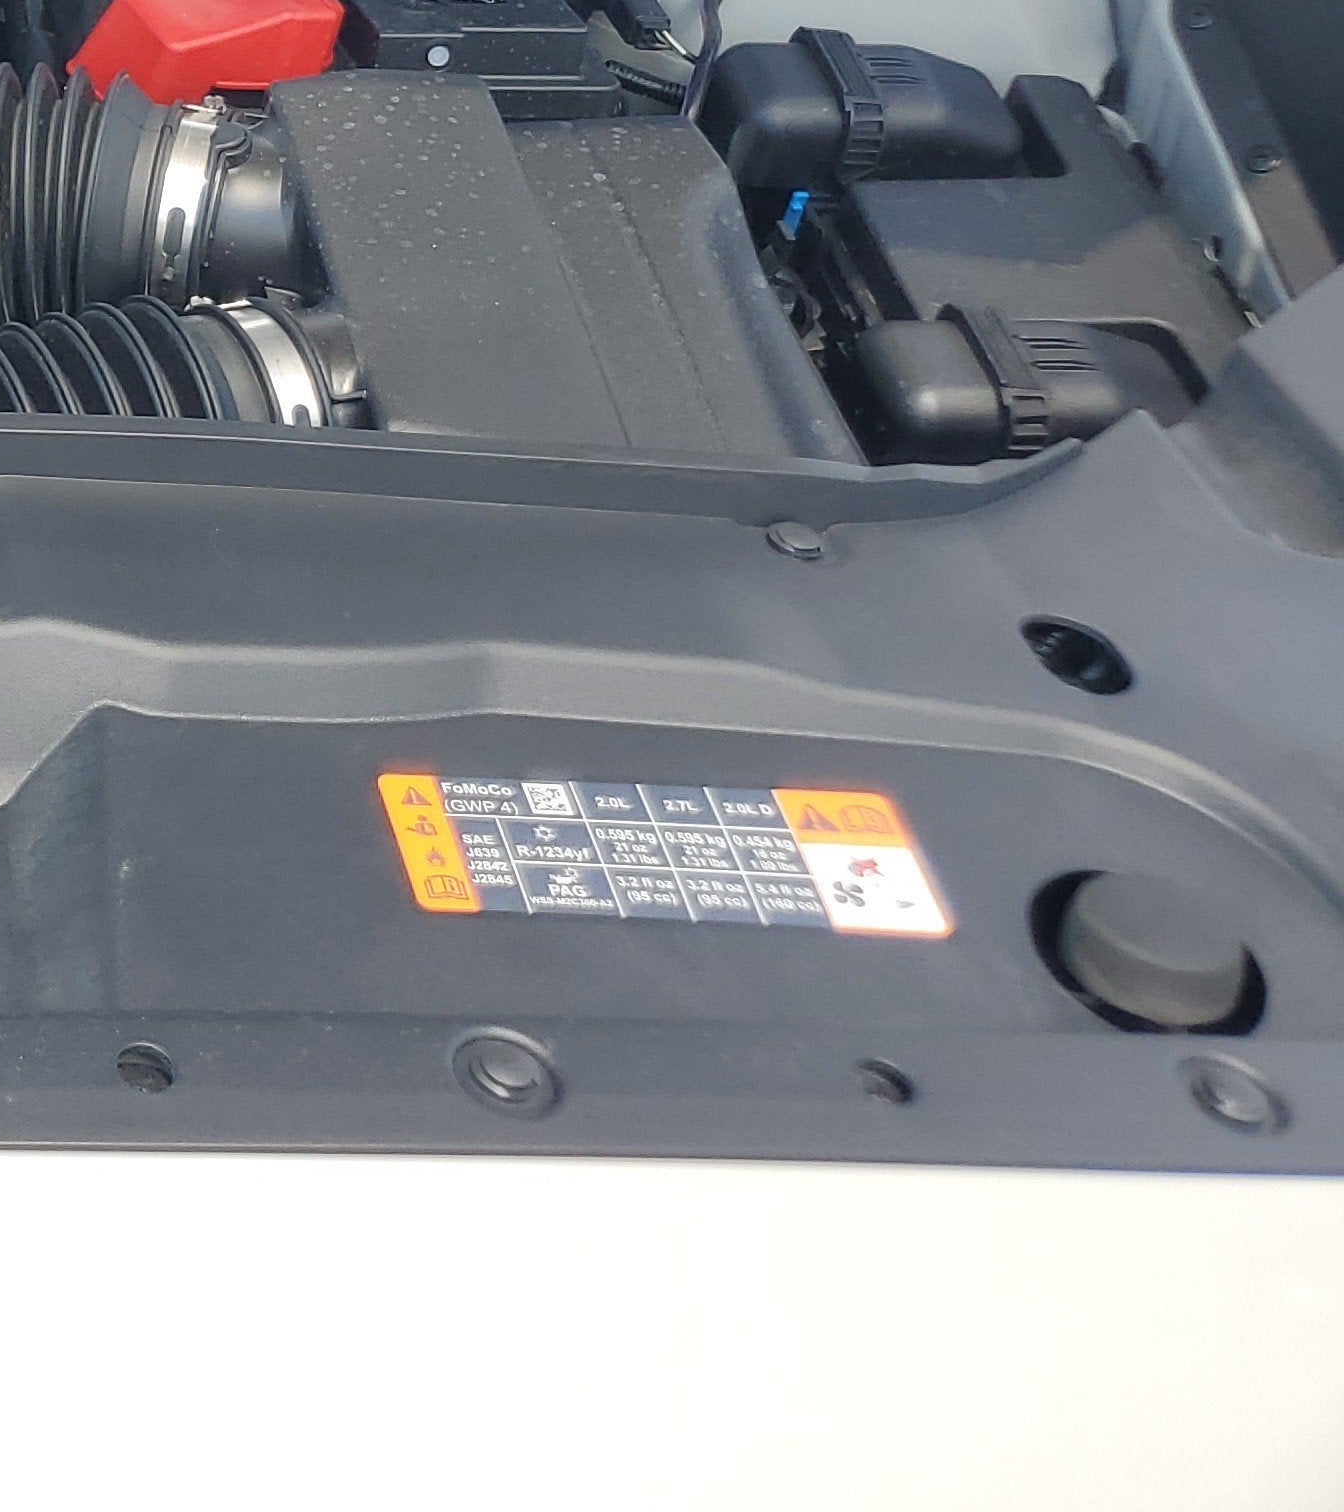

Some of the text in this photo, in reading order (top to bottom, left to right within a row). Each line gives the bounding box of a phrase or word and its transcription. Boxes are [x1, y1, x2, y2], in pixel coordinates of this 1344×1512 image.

[441, 782, 512, 796] FoMoCo
[444, 800, 519, 815] (GWP 4)
[594, 796, 633, 809] 2.0L
[662, 799, 699, 811] 2.7L
[722, 802, 774, 815] 2.0L D
[462, 834, 495, 845] SAE
[595, 828, 658, 845] 0.595 kg
[664, 831, 726, 848] 0.595 kg
[775, 837, 796, 852] kg
[466, 848, 500, 858] J639
[516, 844, 589, 862] R-1234yf
[615, 875, 639, 887] 3.2
[547, 884, 588, 897] PAG
[627, 889, 678, 906] (95 cc)
